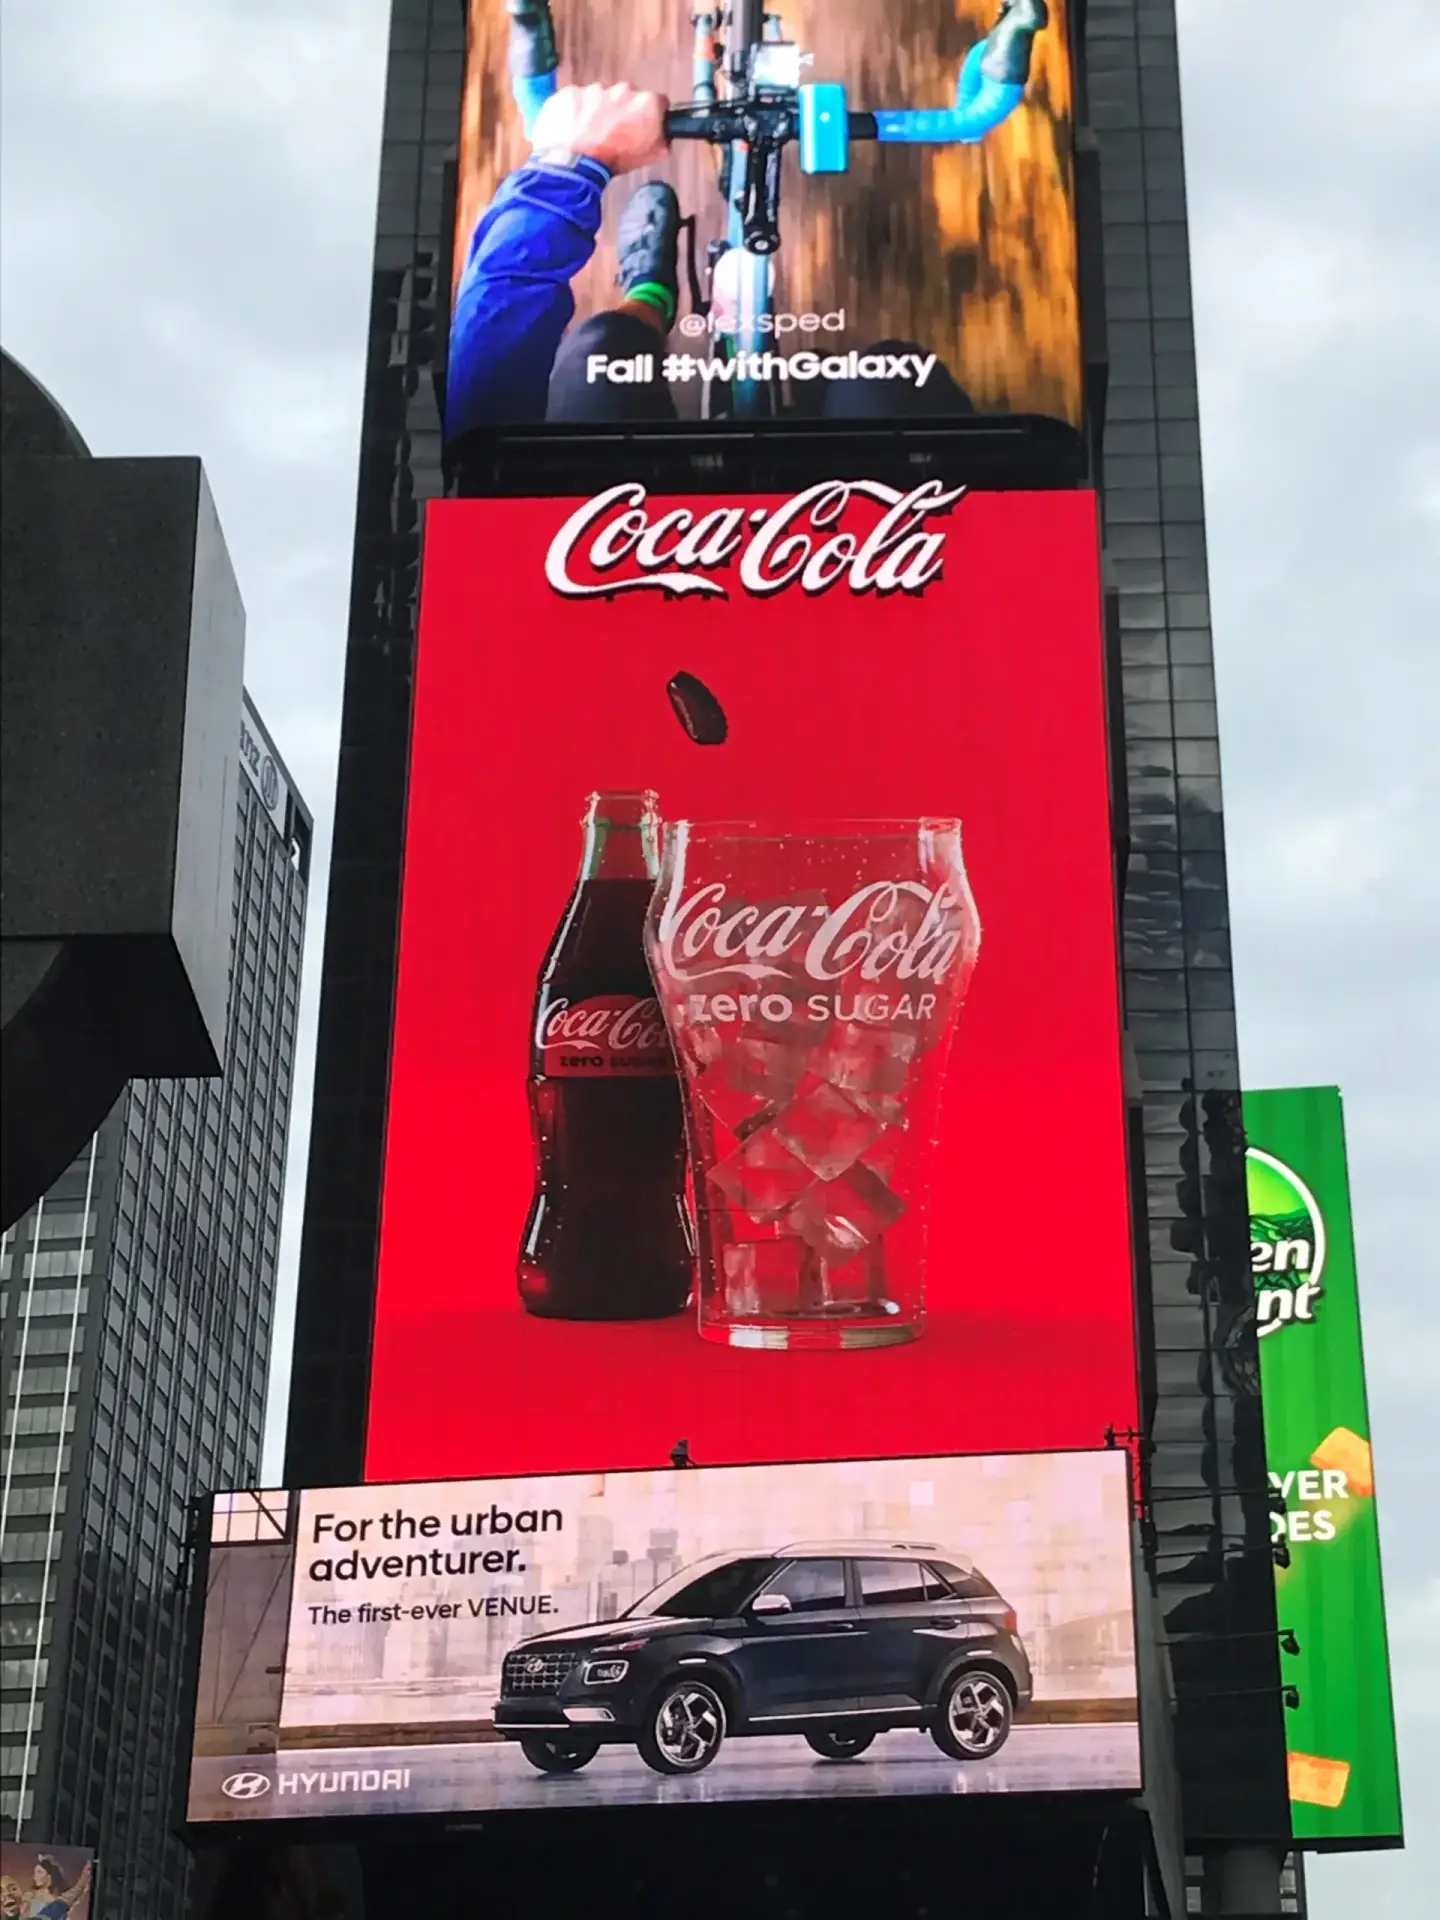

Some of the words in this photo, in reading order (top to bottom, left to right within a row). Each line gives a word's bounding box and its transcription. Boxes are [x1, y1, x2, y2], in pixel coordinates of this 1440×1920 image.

[586, 354, 653, 383] Fall
[662, 350, 937, 387] #withGalaxy
[545, 479, 967, 594] Coca-Cola
[667, 880, 961, 982] Coca-Cola
[690, 993, 793, 1022] zero
[807, 993, 937, 1023] SUGAR
[312, 1513, 373, 1544] For
[379, 1509, 441, 1540] the
[450, 1504, 564, 1536] urban
[309, 1548, 527, 1582] adventurer.
[308, 1605, 351, 1625] The
[358, 1601, 462, 1623] first-ever
[467, 1594, 559, 1618] VENUE.
[277, 1768, 411, 1795] HYUNDAI
